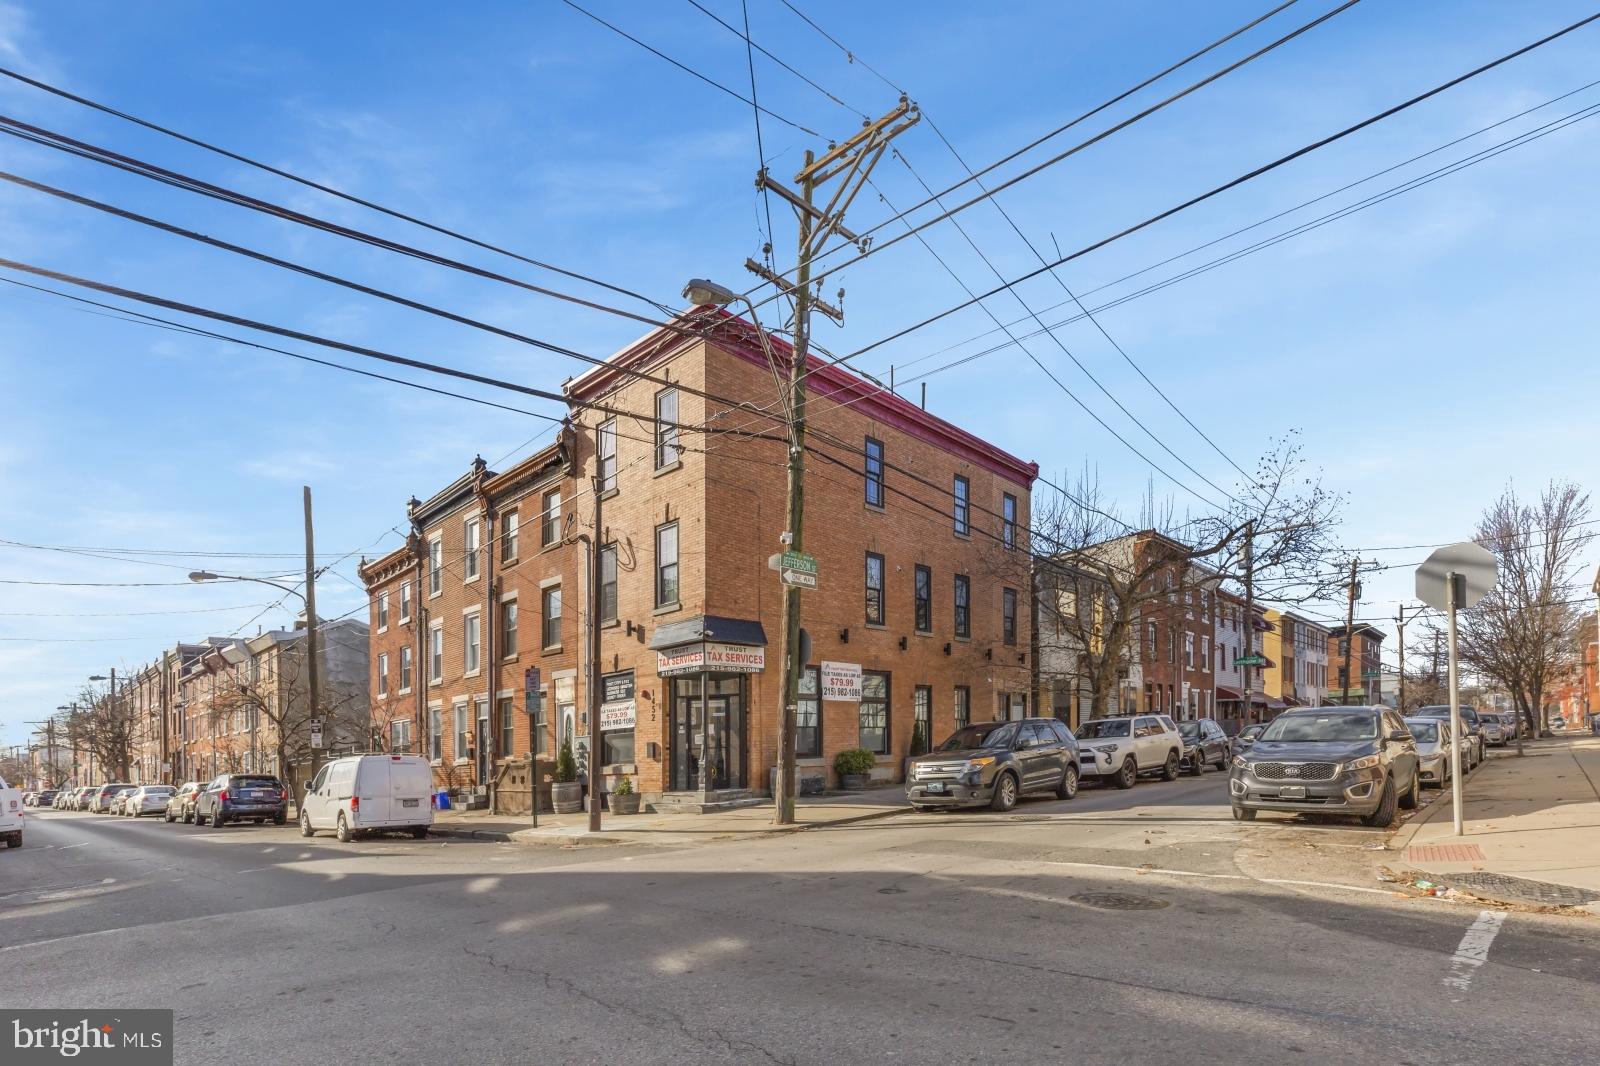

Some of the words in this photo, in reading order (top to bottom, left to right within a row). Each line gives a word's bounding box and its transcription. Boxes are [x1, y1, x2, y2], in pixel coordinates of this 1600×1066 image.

[783, 556, 811, 571] JEFFERSON
[791, 573, 803, 582] ONE
[803, 576, 815, 585] WAY
[724, 645, 748, 653] TRUST
[659, 657, 671, 668] TAX
[671, 652, 703, 666] SERVICES
[707, 651, 723, 662] TAX
[725, 653, 763, 665] SERVICES
[830, 677, 854, 687] $79.99
[606, 711, 628, 720] $79.99
